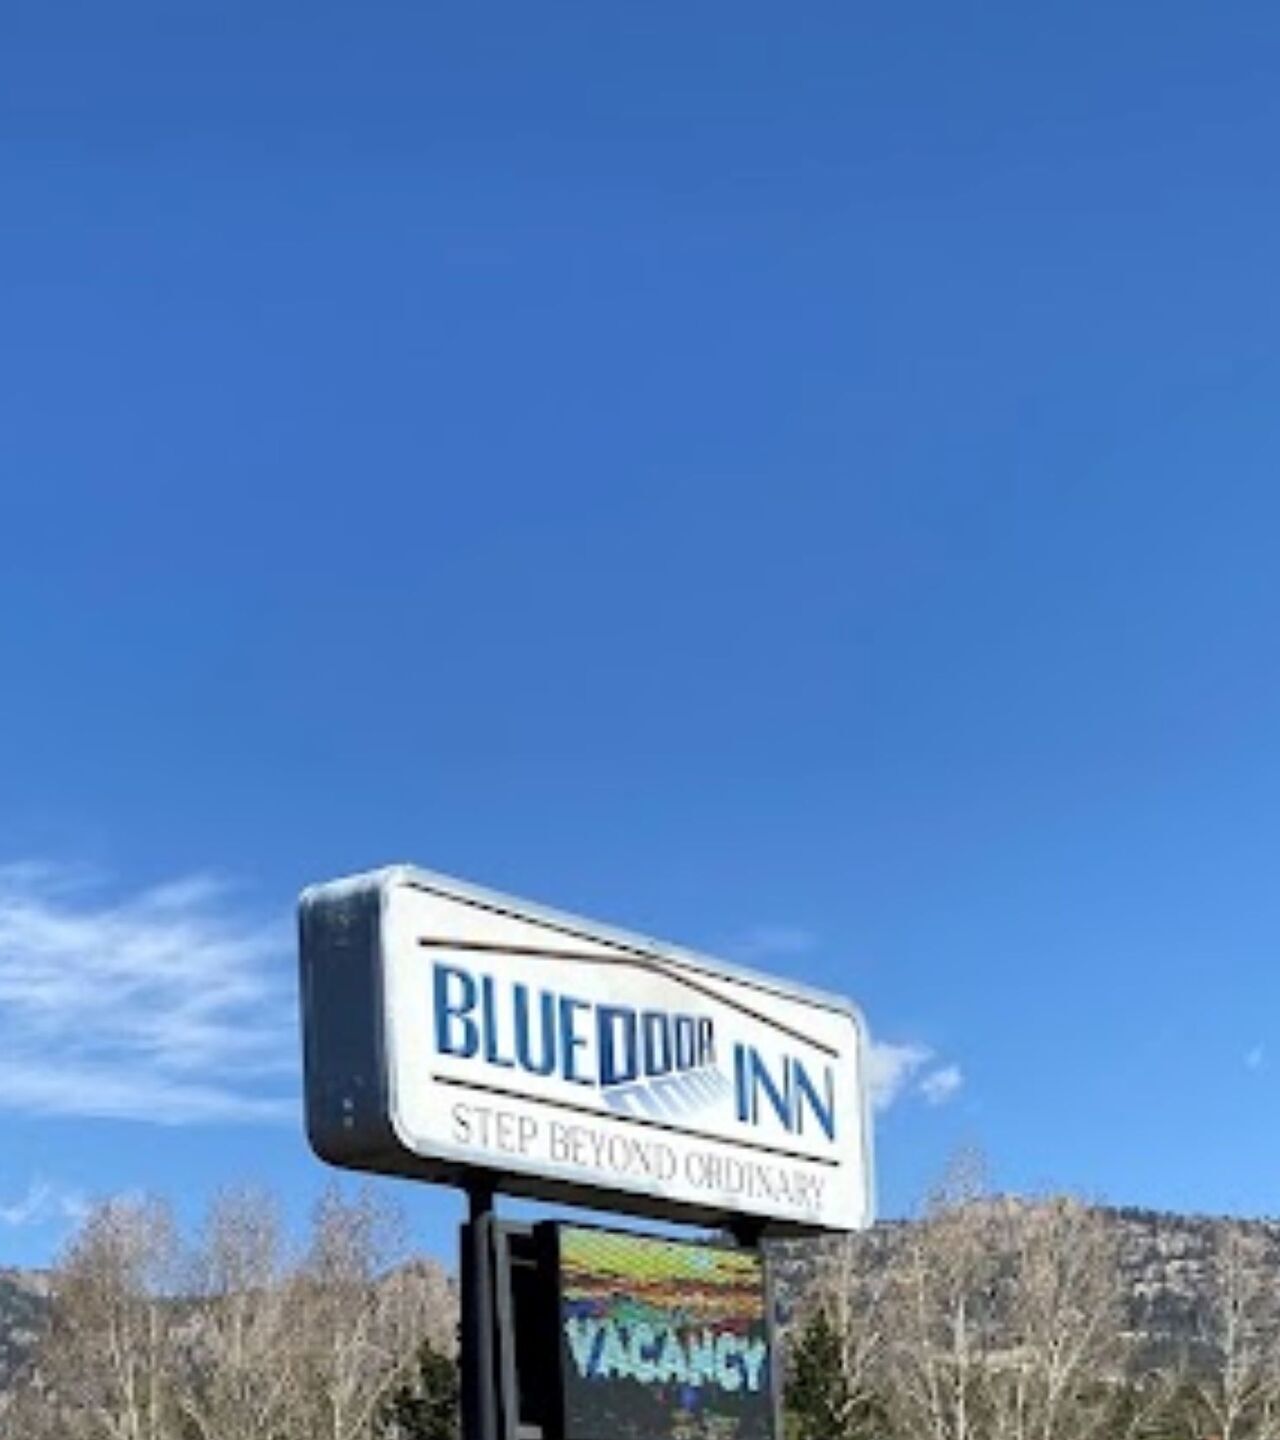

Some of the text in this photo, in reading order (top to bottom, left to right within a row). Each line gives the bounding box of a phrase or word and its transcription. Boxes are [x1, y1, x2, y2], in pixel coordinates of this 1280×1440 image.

[734, 1042, 835, 1143] INN
[452, 1103, 825, 1210] STEP BEYOND ORDINARY
[565, 1317, 768, 1392] VACANCY
